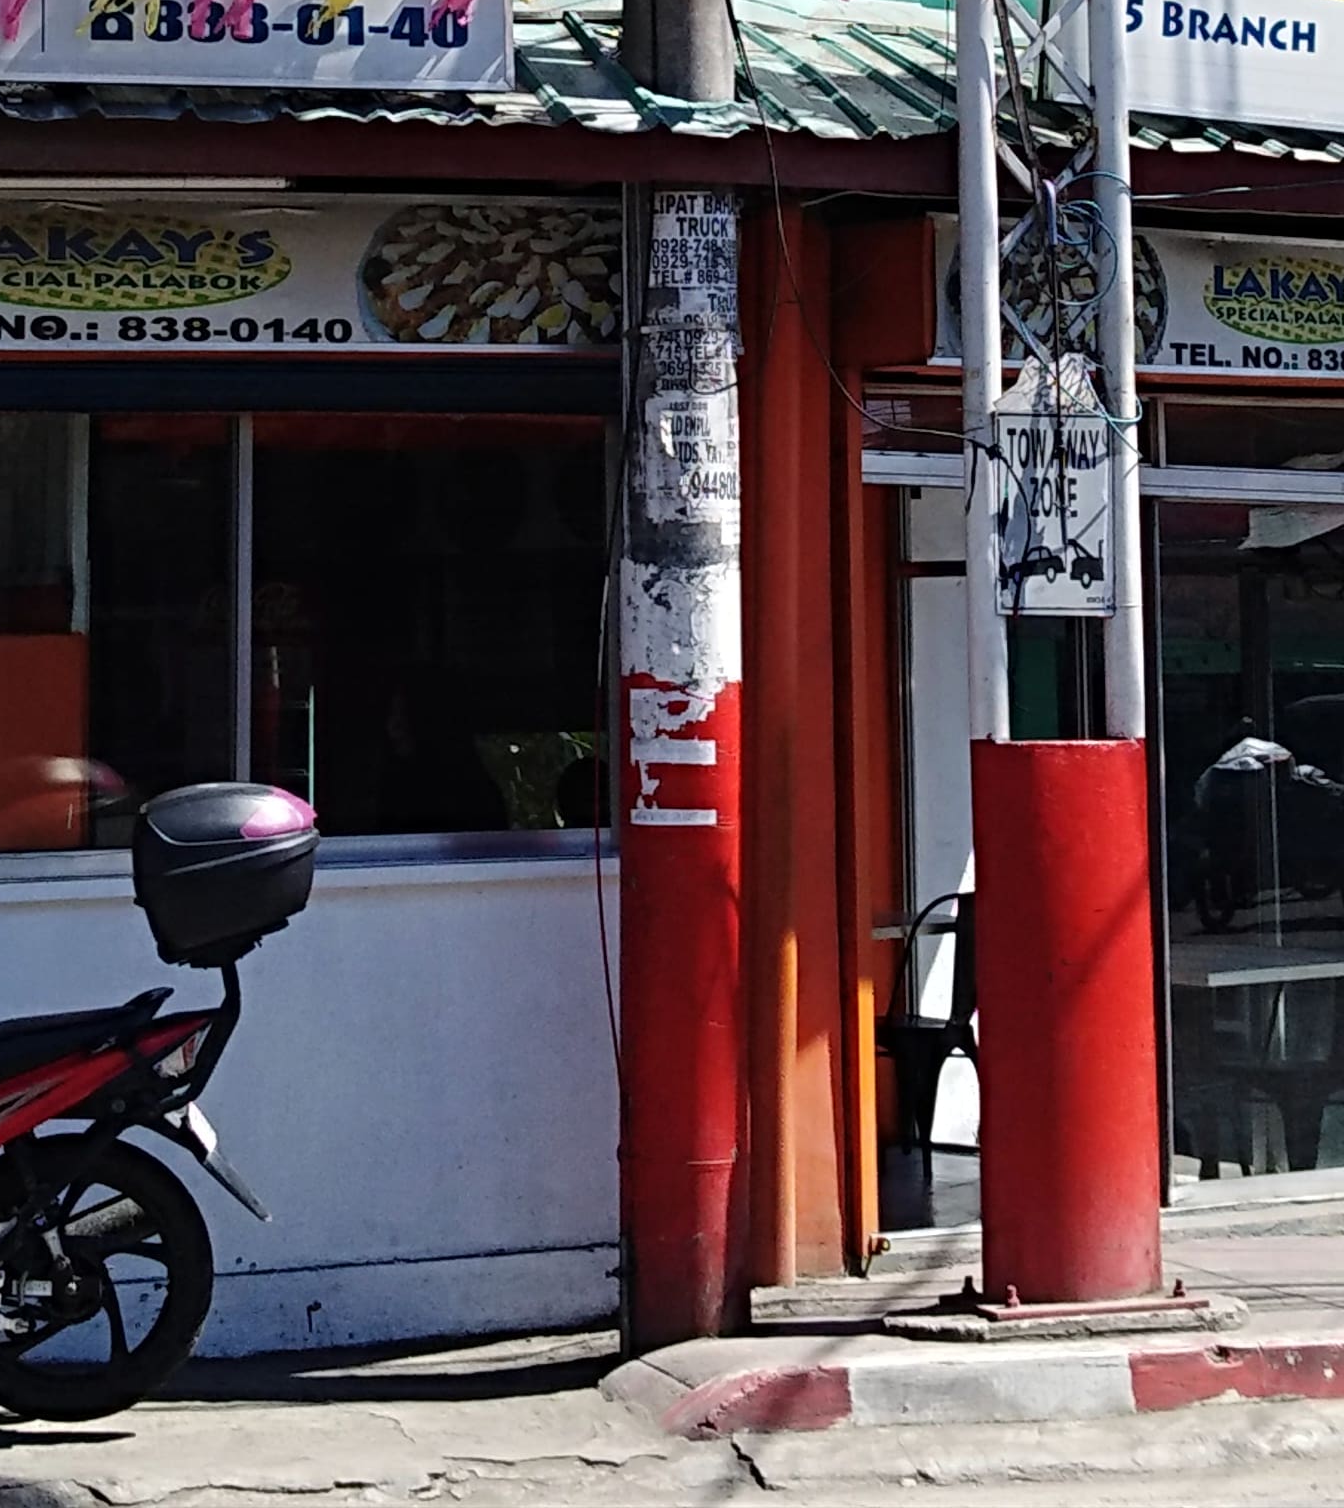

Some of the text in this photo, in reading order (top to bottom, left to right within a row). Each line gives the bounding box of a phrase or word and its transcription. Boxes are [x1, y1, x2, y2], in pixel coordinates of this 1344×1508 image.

[1161, 0, 1317, 53] BRANCH
[676, 217, 728, 238] TRUCK
[94, 272, 263, 291] PALABOK
[1215, 305, 1290, 324] SPECIAL
[117, 317, 353, 343] 838-0140
[1169, 342, 1232, 368] TEL.
[1242, 345, 1299, 370] NO.:
[1007, 427, 1047, 469] TOW
